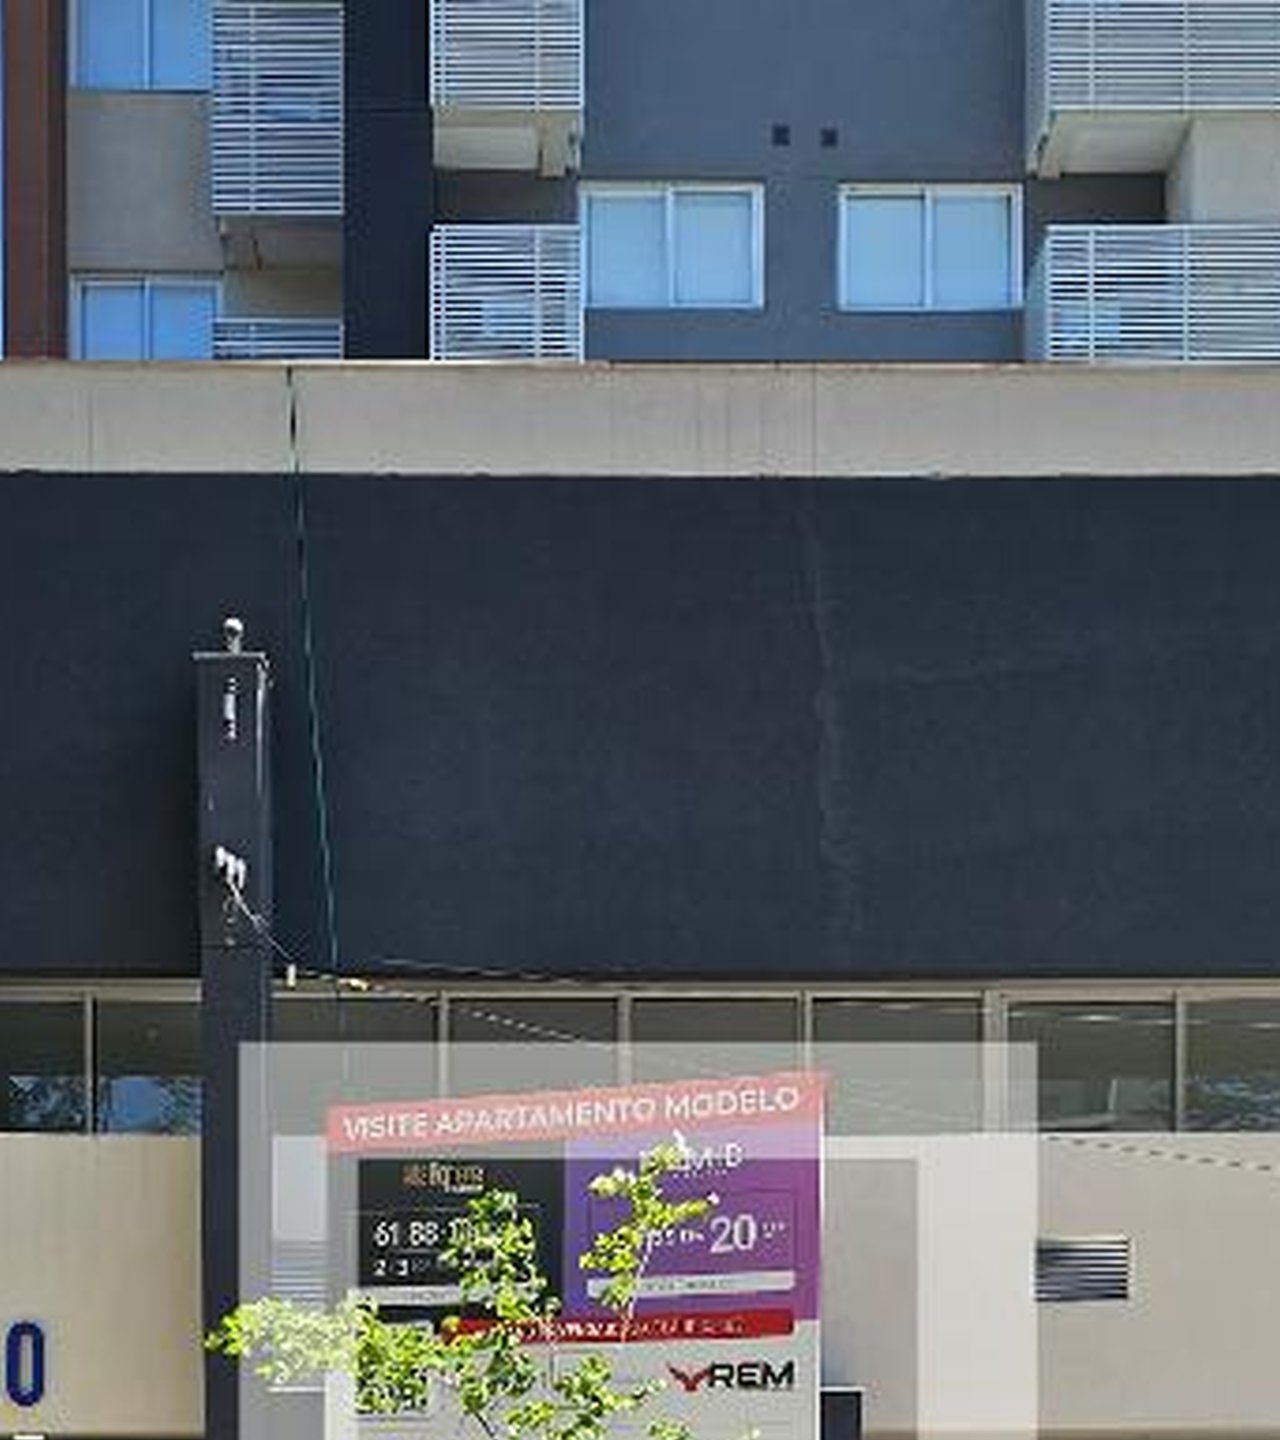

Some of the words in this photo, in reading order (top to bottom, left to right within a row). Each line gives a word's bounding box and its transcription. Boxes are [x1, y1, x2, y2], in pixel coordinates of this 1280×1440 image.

[343, 1112, 428, 1141] VISITE
[434, 1097, 656, 1134] APARTAMENTO
[665, 1086, 799, 1120] MODELO
[709, 1213, 757, 1254] 20
